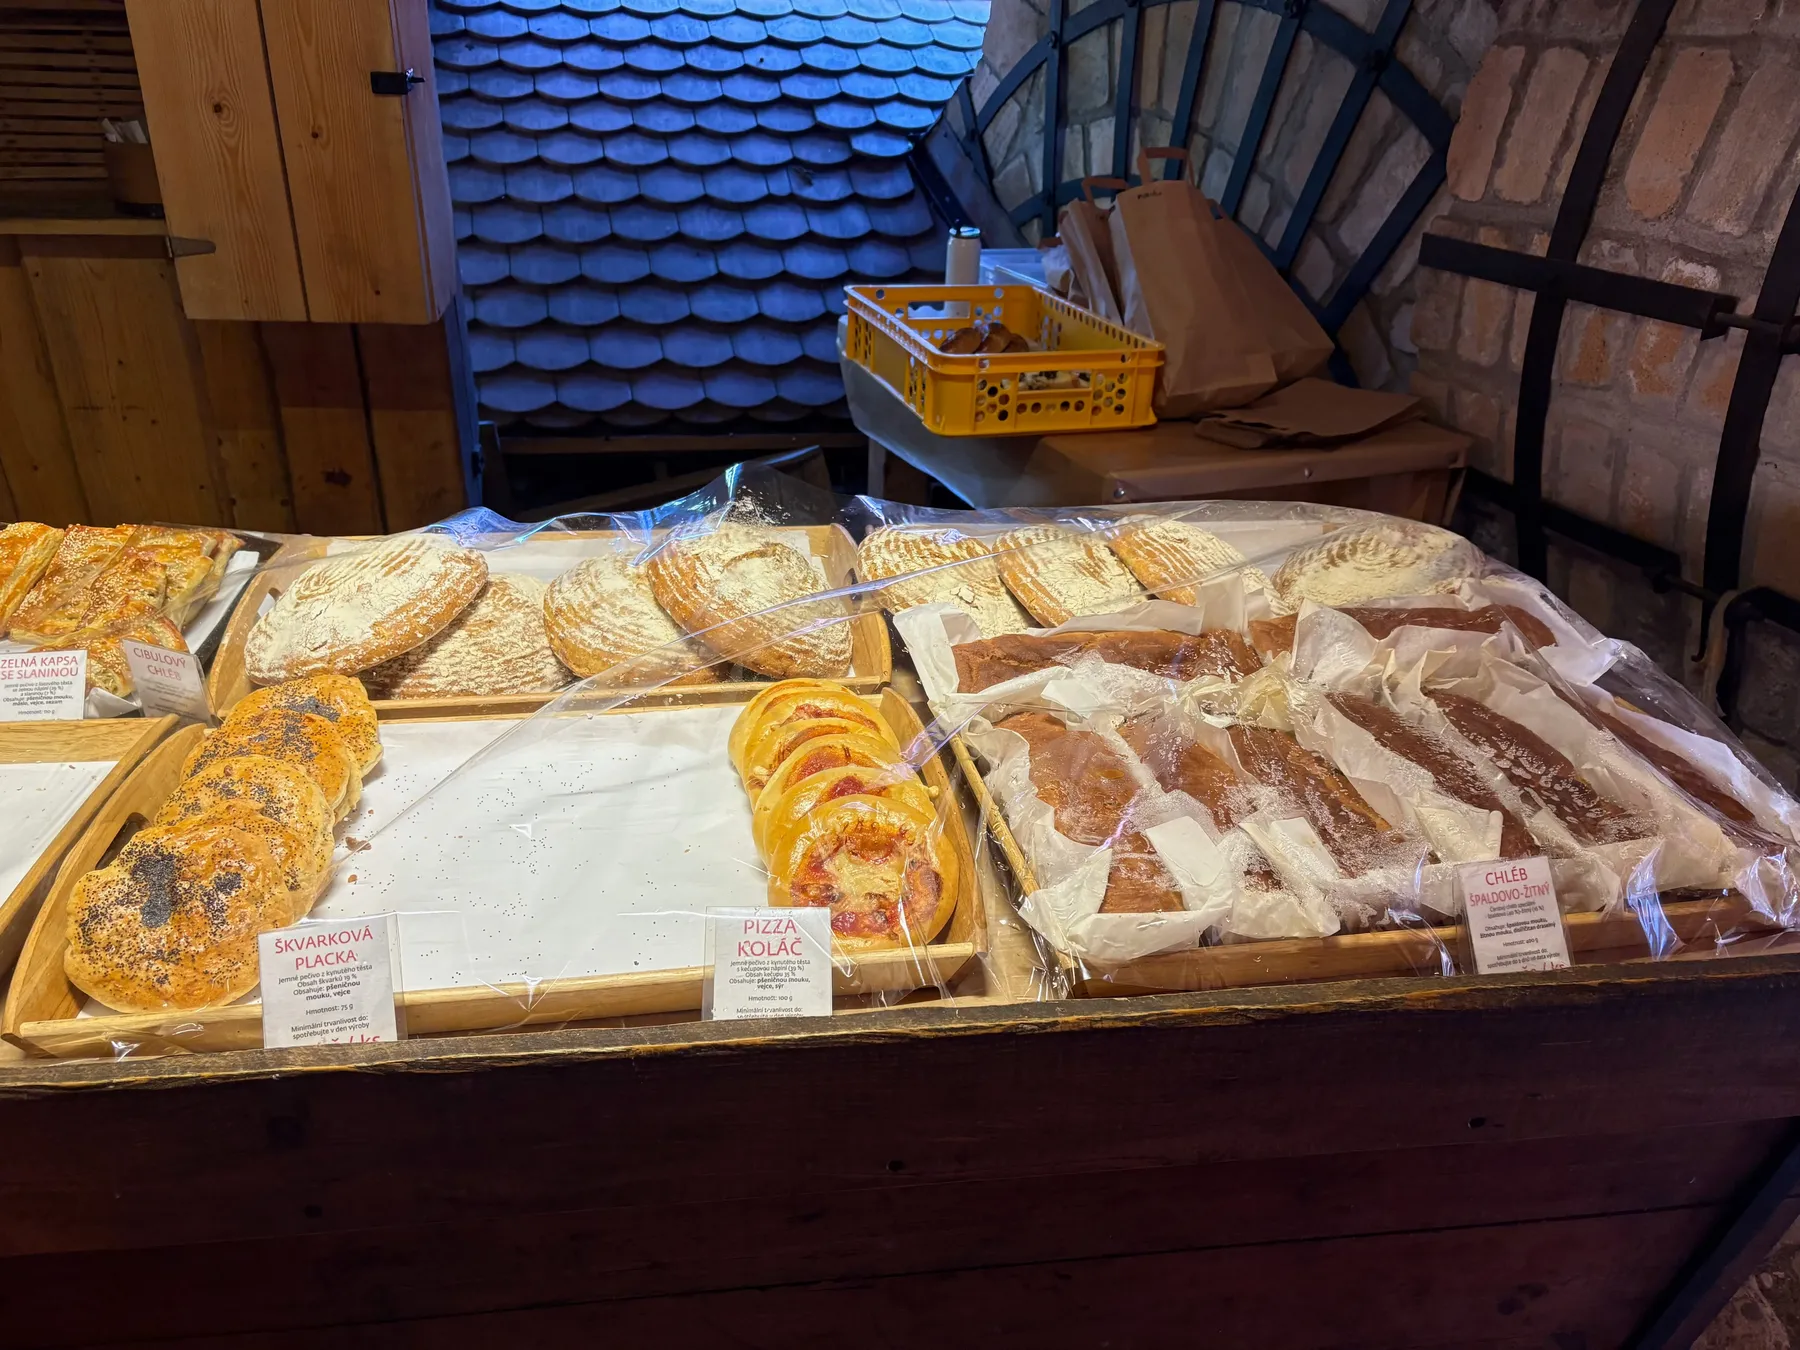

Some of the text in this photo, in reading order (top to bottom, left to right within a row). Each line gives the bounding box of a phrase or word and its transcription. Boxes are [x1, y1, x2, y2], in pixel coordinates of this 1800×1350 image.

[0, 656, 78, 669] ZELNÁ KAPSA
[133, 647, 186, 668] CIBULOVÝ
[1, 667, 79, 680] SE SLANINOU
[1485, 866, 1528, 886] CHLÉB
[1469, 881, 1550, 907] ŠPALDOVO-ŽITNÝ
[743, 918, 797, 934] PIZZA
[275, 925, 373, 954] ŠKVARKOVÁ
[738, 937, 803, 956] KOLÁČ
[295, 949, 357, 970] PLACKA
[278, 974, 299, 984] Jemné
[299, 972, 320, 981] pečivo
[326, 966, 356, 977] kynutého
[356, 964, 373, 972] těsta
[297, 979, 317, 988] Obsah
[318, 975, 342, 985] škvarků
[293, 980, 361, 996] Obsahuje: pšeničnou
[306, 989, 351, 1001] mouku, vejce
[305, 1005, 339, 1015] Hmotnost:
[291, 1020, 323, 1032] Minimální
[323, 1016, 357, 1028] trvanlivost
[292, 1028, 330, 1040] spotřebujte
[335, 1025, 348, 1033] den
[348, 1022, 370, 1032] výroby
